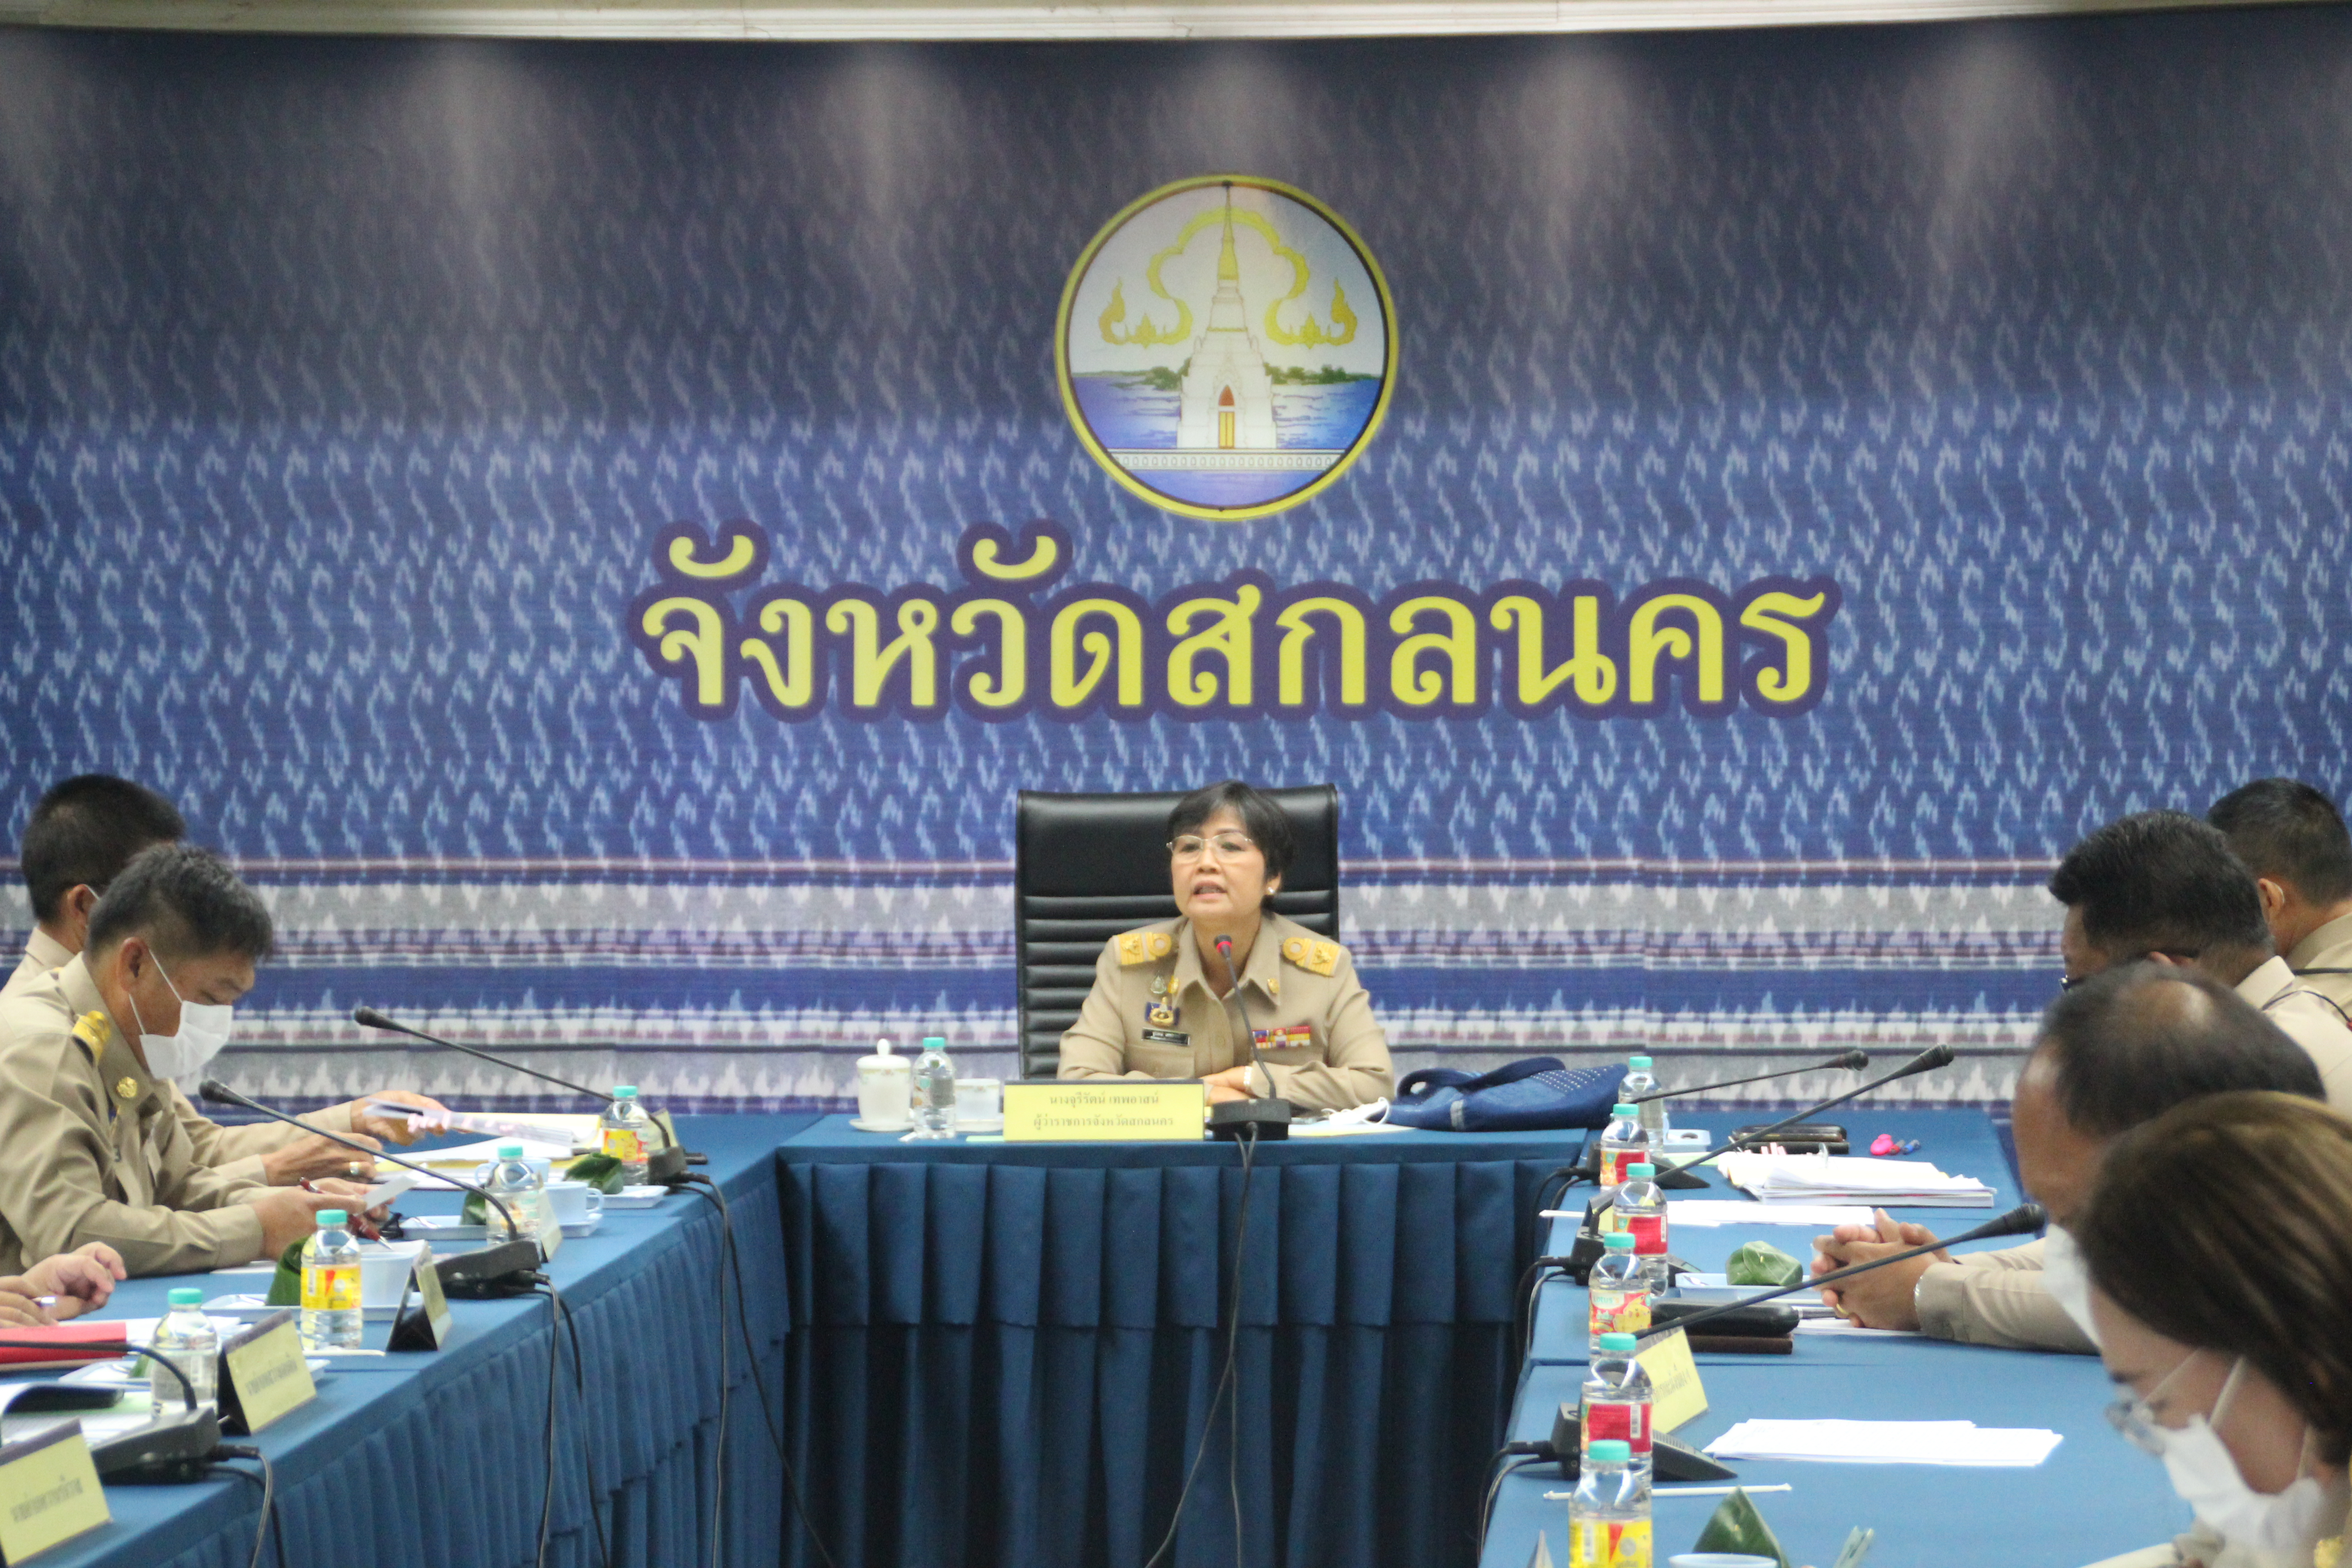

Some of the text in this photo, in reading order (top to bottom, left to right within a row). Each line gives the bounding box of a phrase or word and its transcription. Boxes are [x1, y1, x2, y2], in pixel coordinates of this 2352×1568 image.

[642, 535, 1825, 707] จังหวัดสกลนคร
[1049, 1090, 1159, 1108] นางจุรีรัตน์ เทพอาสน์
[1034, 1113, 1174, 1130] ผู้ว่าราชการจังหวัดสกลนคร
